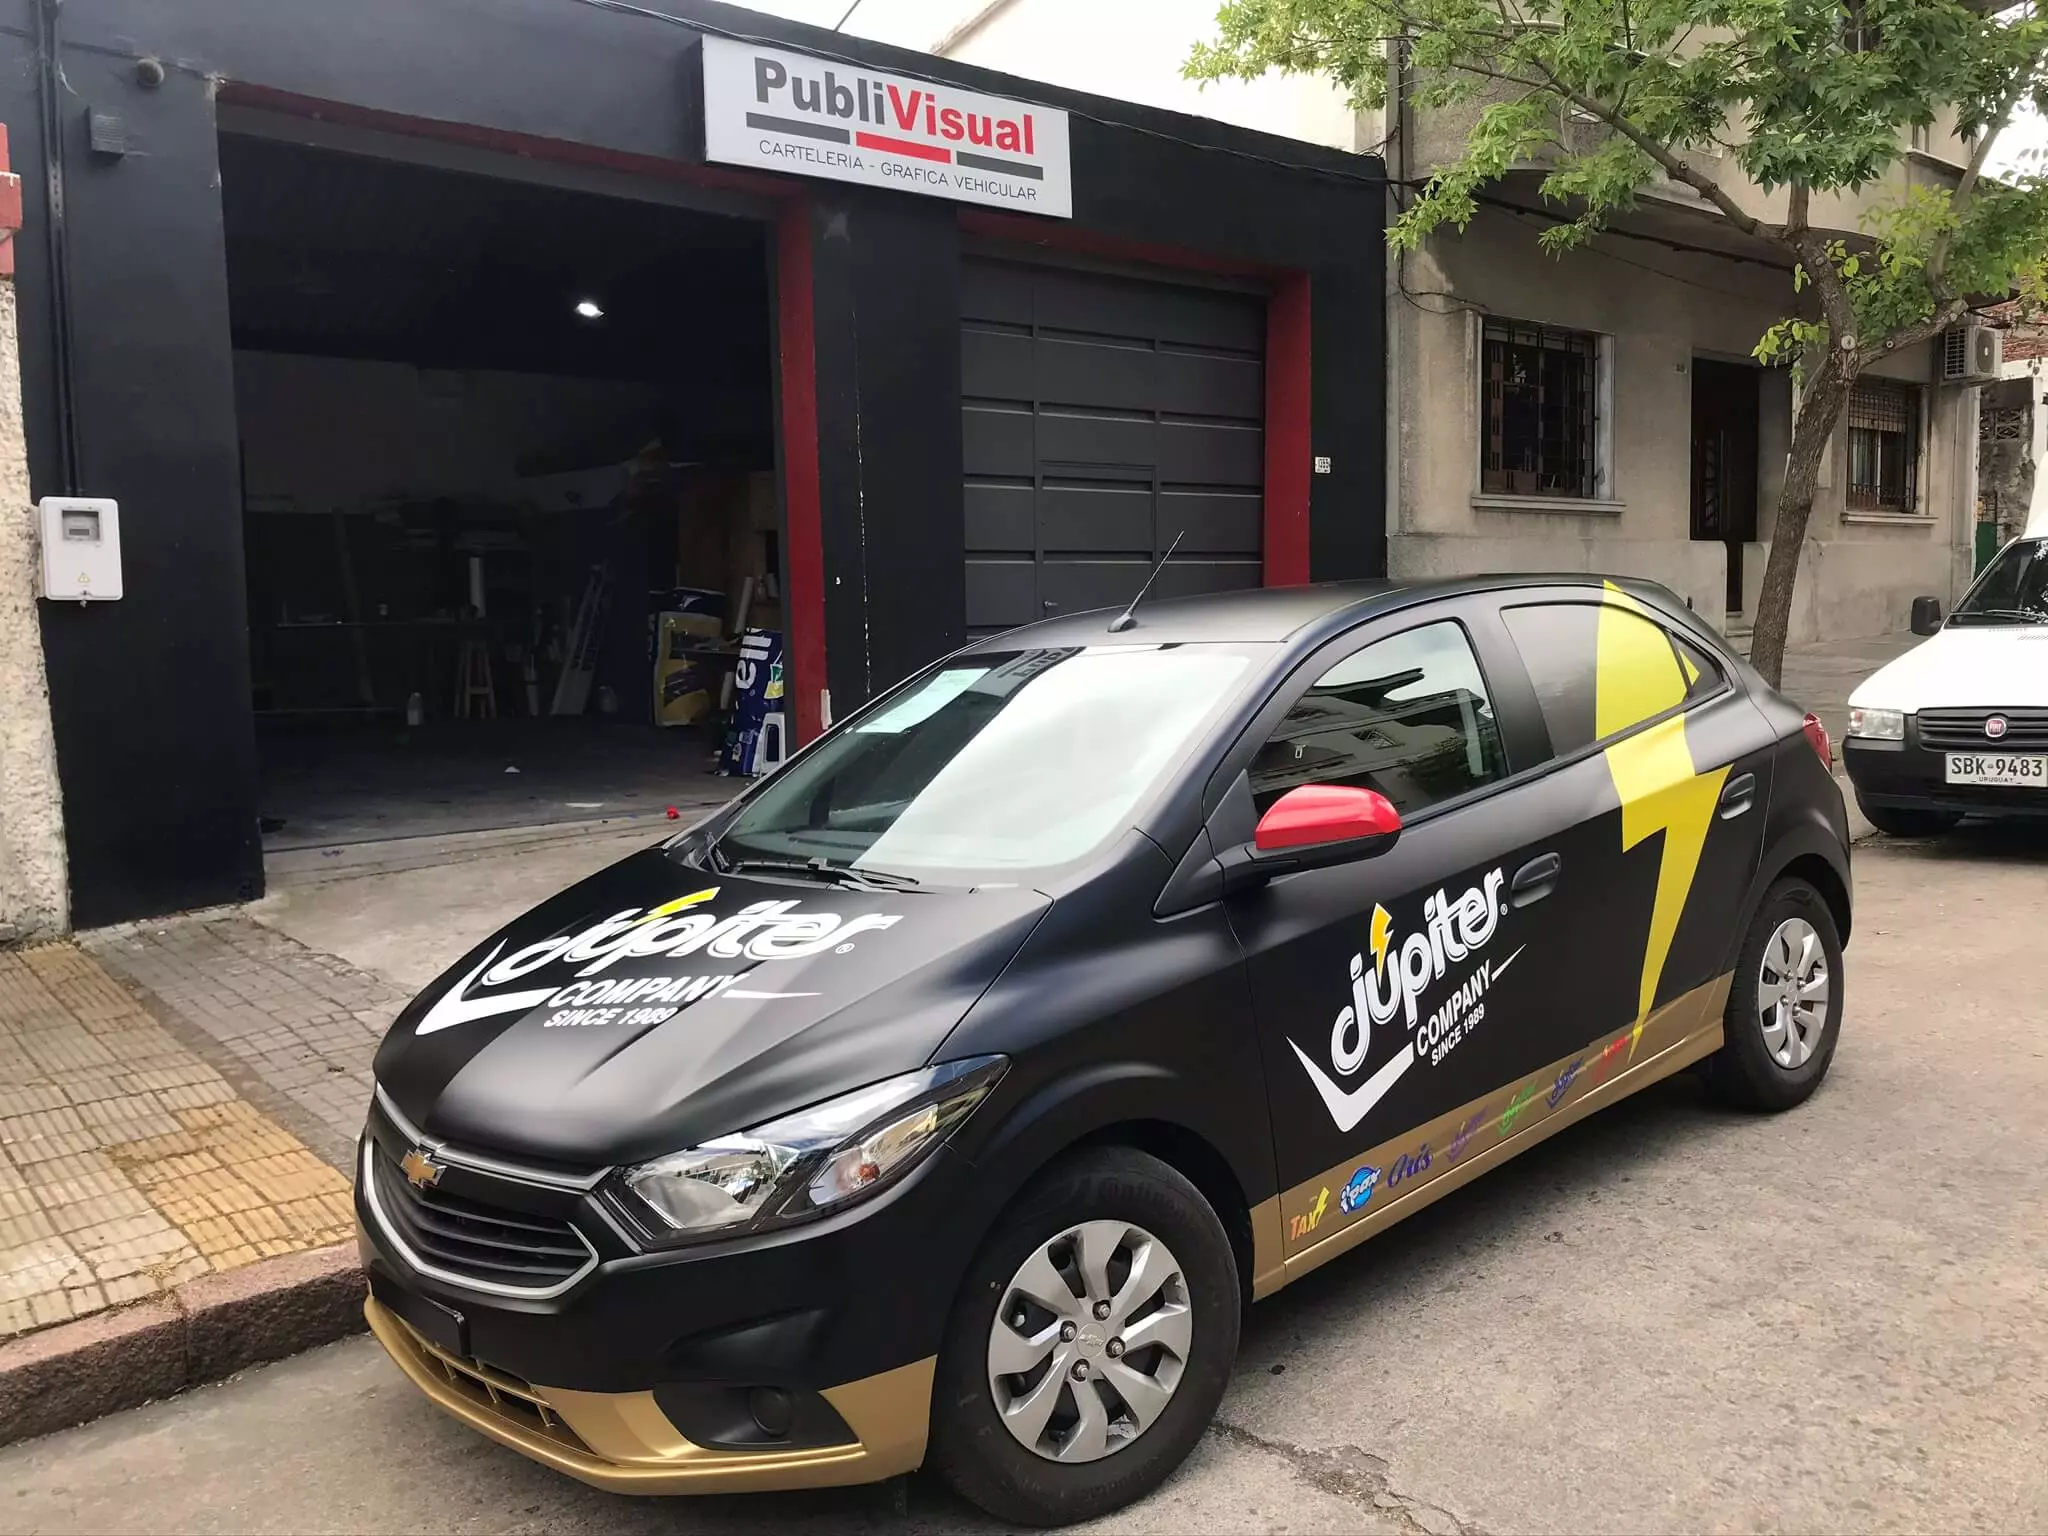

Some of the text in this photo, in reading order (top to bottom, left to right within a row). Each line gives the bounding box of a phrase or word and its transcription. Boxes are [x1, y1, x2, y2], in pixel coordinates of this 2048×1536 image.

[754, 56, 1035, 156] PubliVisual
[759, 138, 865, 171] CARTELERIA
[880, 161, 950, 187] GRAFICA
[953, 174, 1037, 201] VEHICULAR
[544, 1005, 681, 1028] SINCE 1989
[547, 972, 750, 1008] COMPANY
[1416, 958, 1493, 1057] COMPANY
[1431, 1002, 1486, 1067] SINCE 1989
